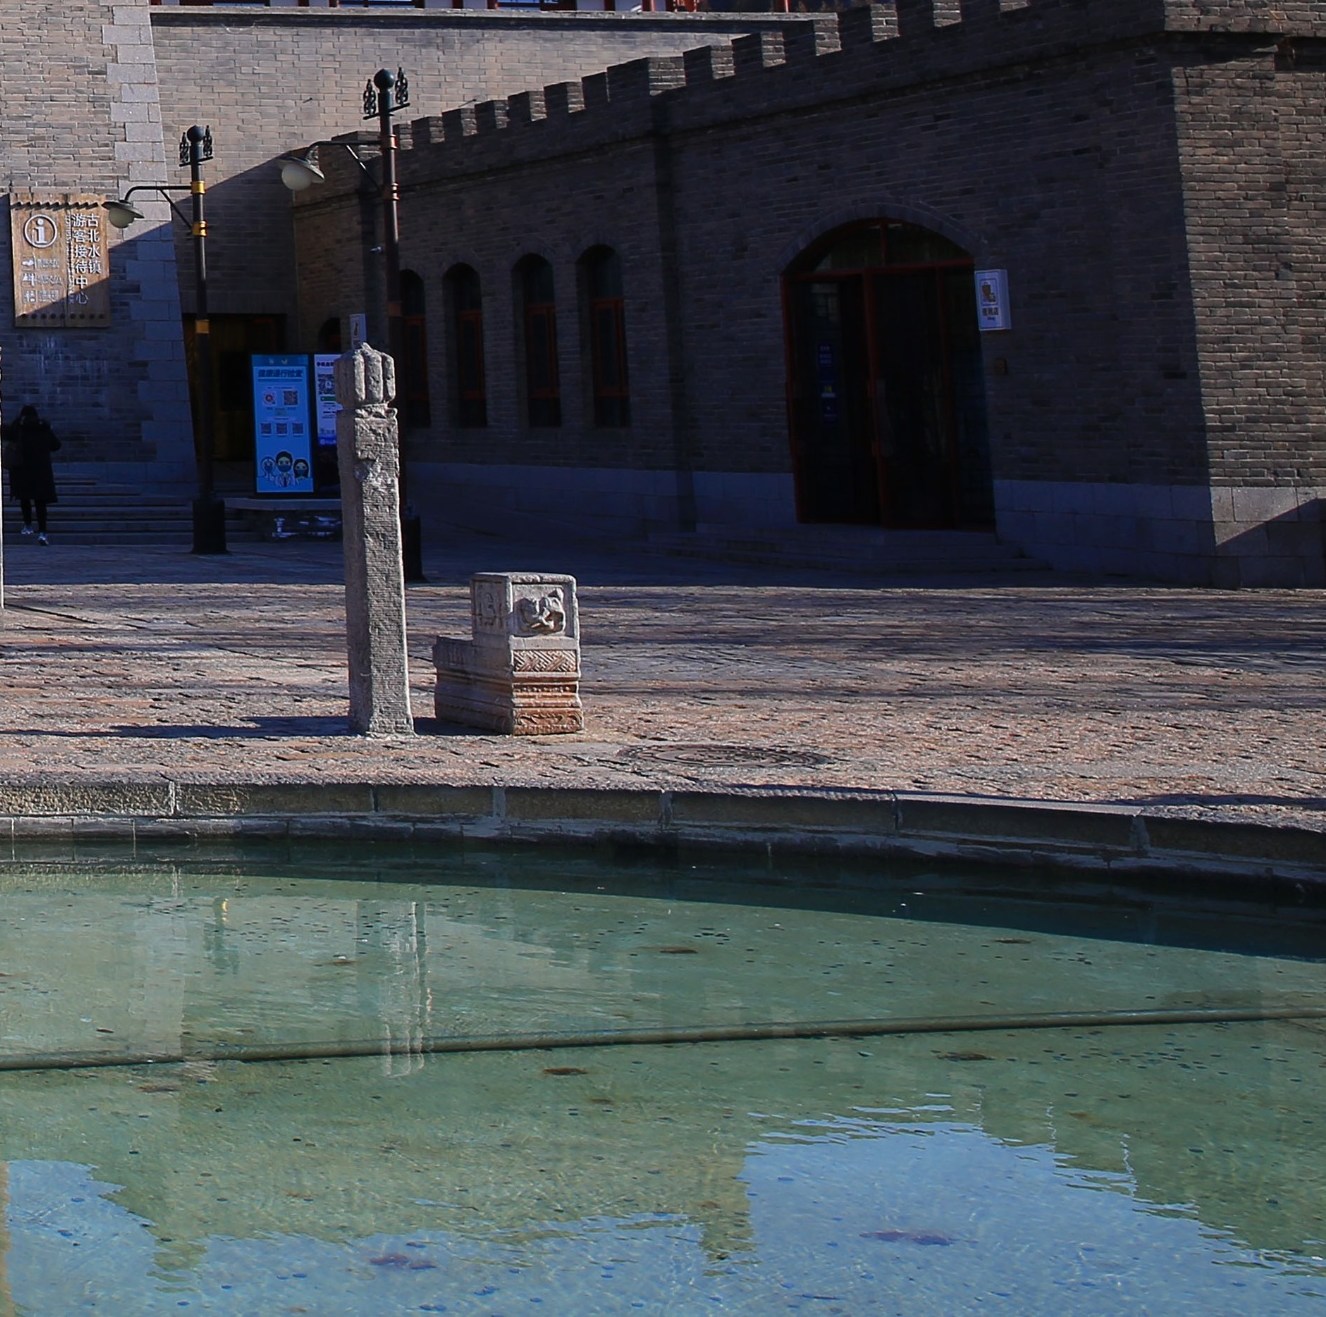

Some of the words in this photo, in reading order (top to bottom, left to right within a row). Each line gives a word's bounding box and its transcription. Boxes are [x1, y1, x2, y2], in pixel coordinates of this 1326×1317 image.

[73, 214, 88, 304] 游客接待中心
[87, 214, 101, 274] 古北水镇
